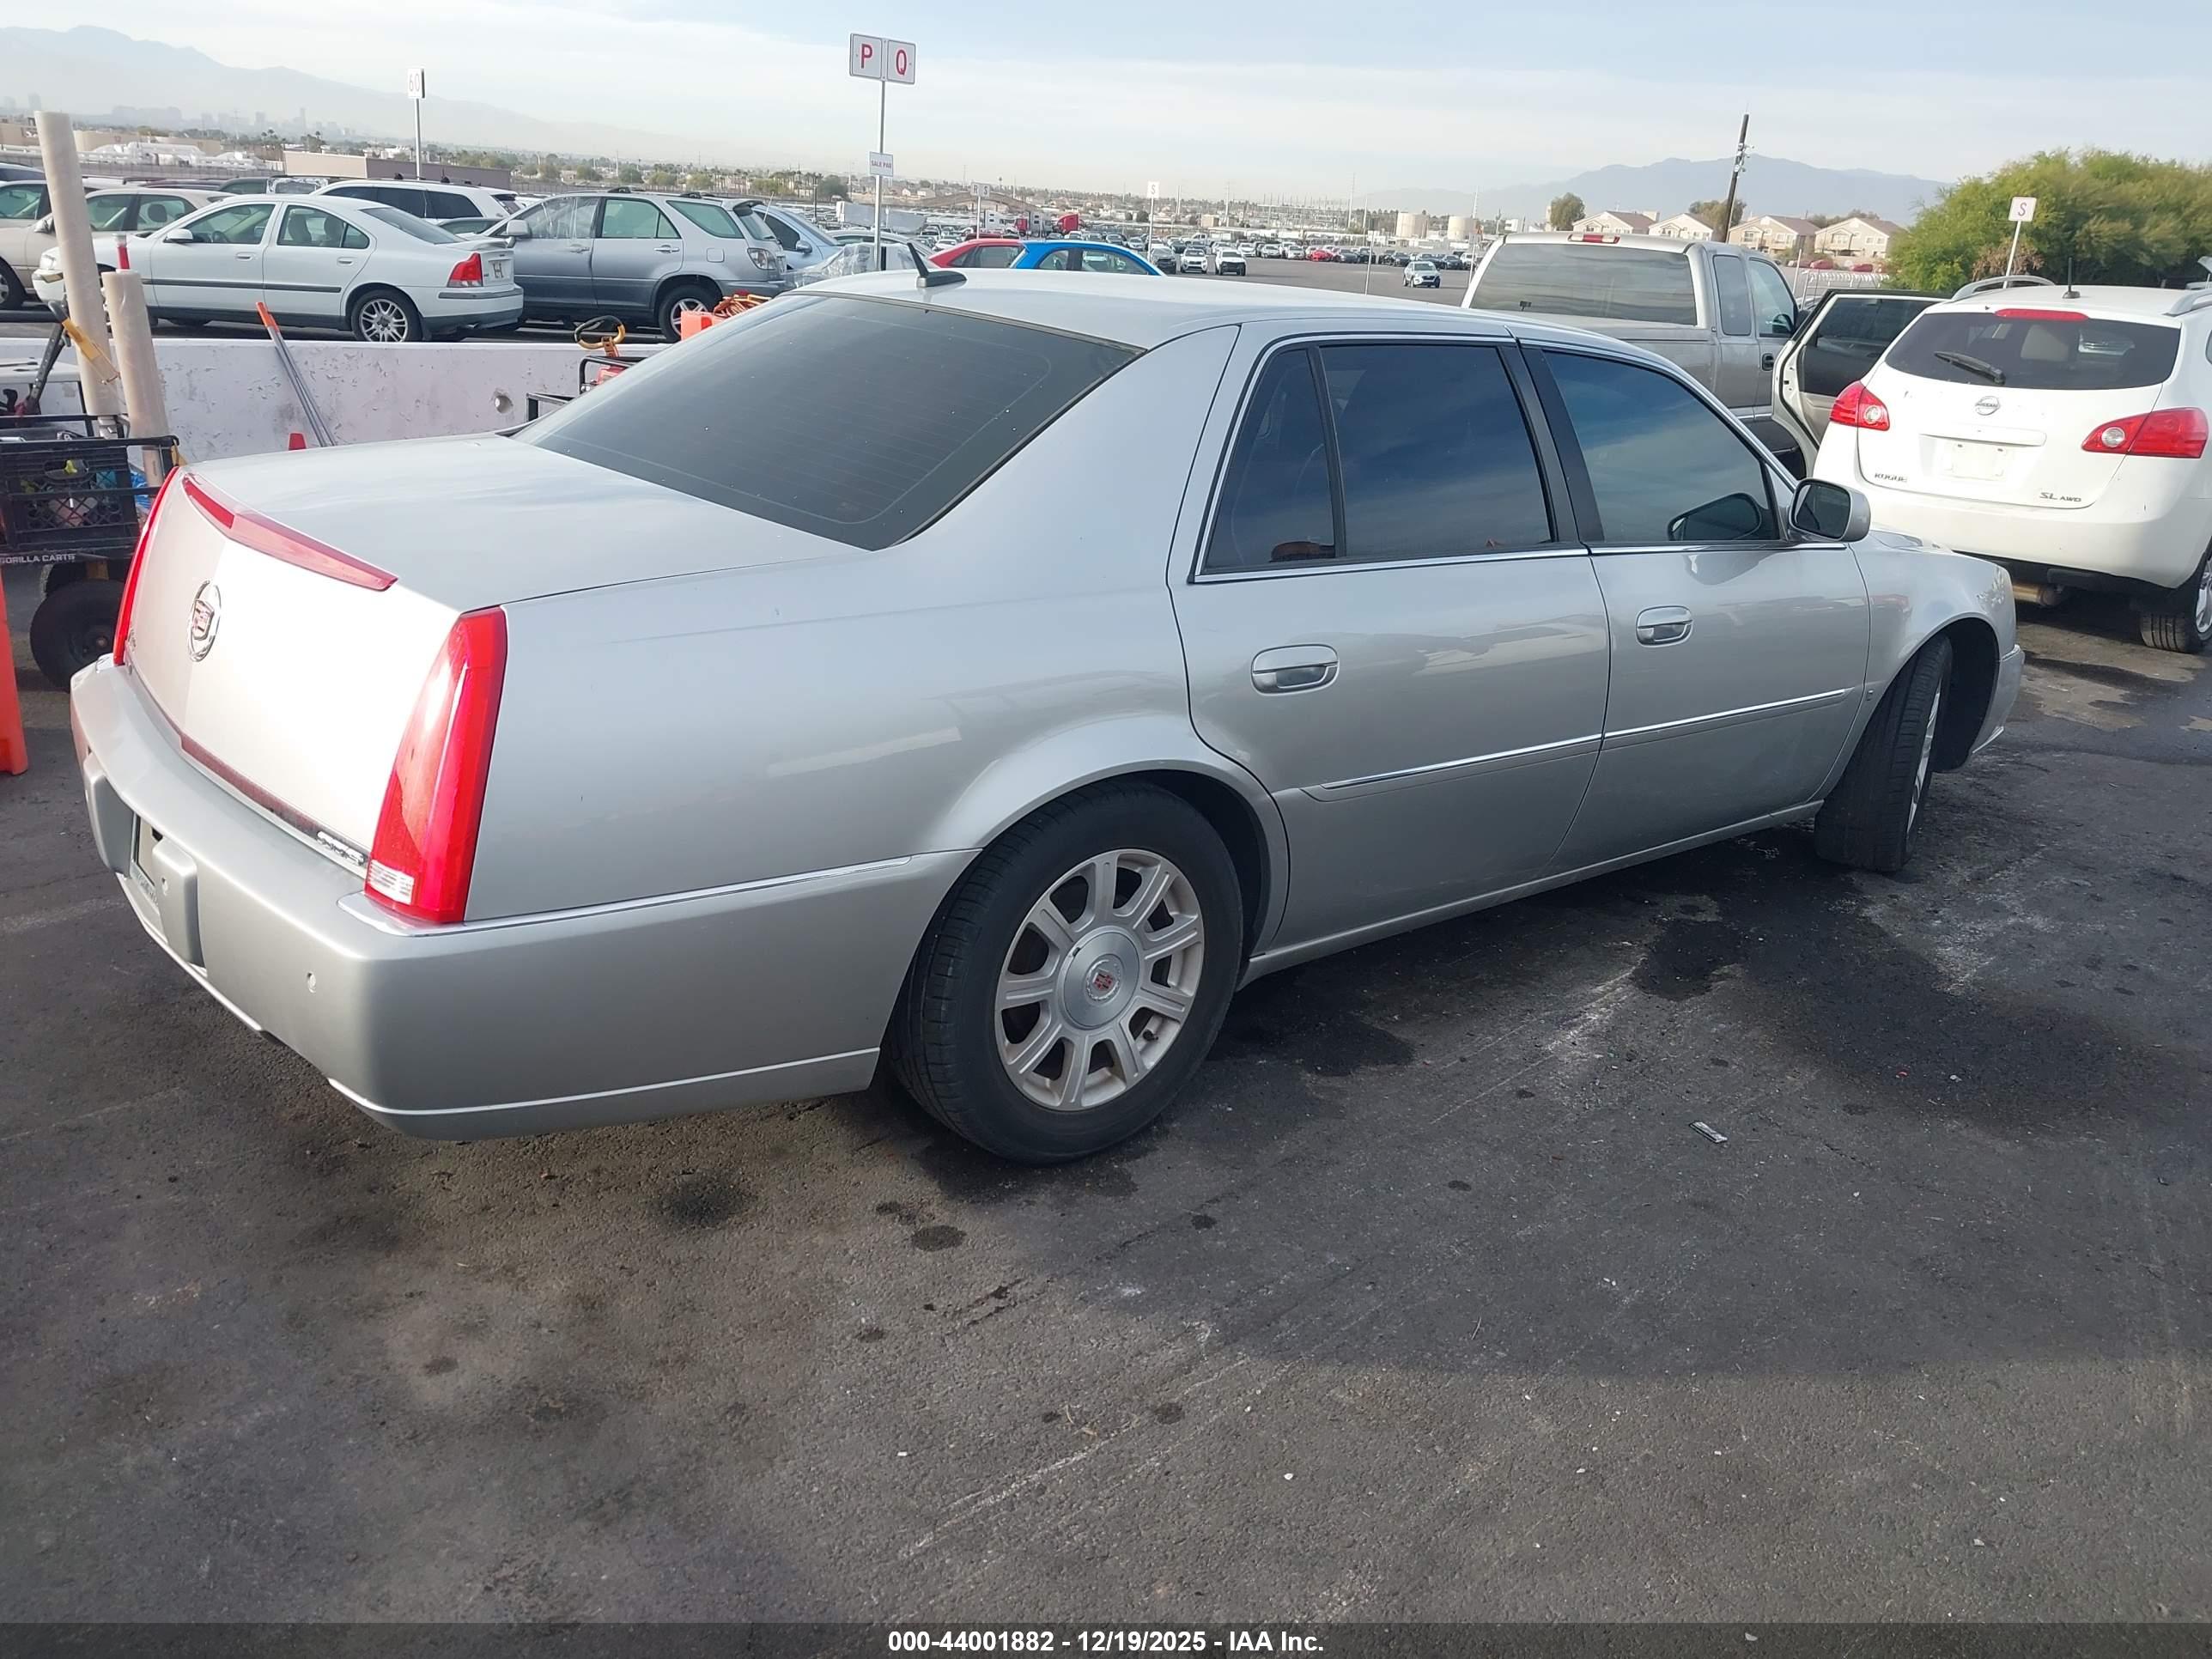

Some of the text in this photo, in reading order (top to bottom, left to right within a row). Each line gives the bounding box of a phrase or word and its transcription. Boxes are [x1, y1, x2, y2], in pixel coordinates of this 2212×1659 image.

[861, 44, 872, 69] P
[896, 49, 907, 76] Q
[409, 73, 420, 92] 60
[983, 185, 988, 195] S
[1151, 184, 1156, 195] S
[2018, 202, 2027, 216] S
